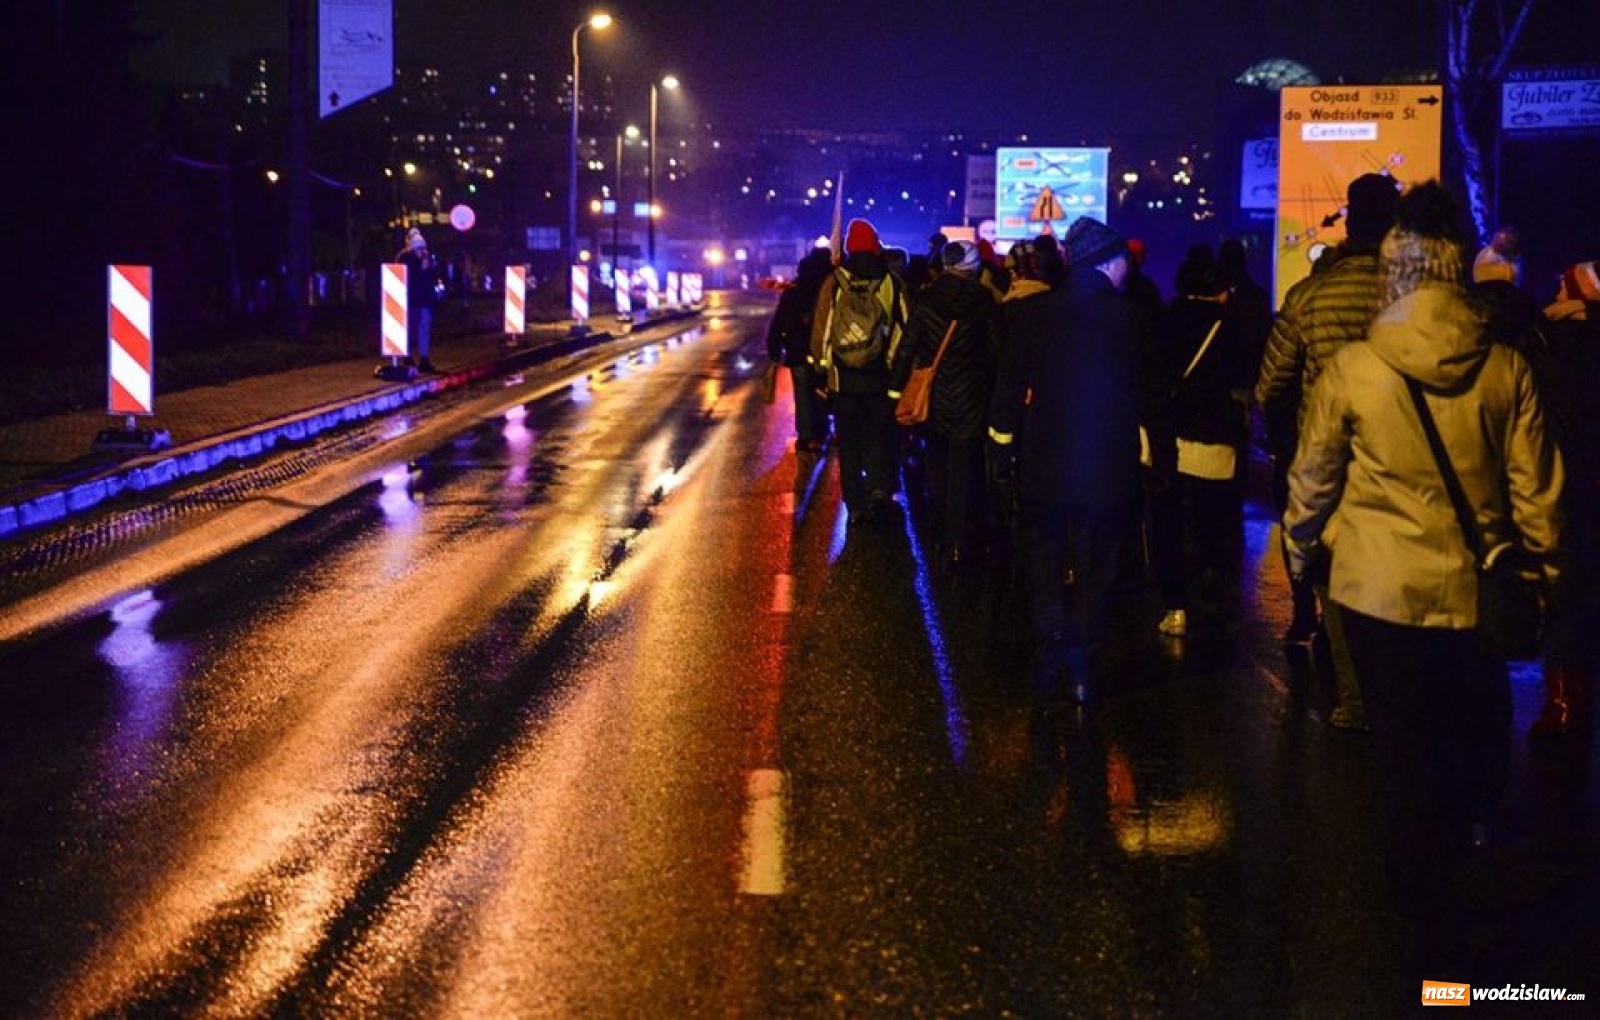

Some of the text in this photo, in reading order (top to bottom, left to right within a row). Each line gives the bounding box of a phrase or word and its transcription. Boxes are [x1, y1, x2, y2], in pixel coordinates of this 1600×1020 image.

[1310, 90, 1397, 104] Objazd 933
[1508, 85, 1576, 112] Jubiler
[1284, 107, 1302, 121] do
[1309, 125, 1370, 138] Centrum
